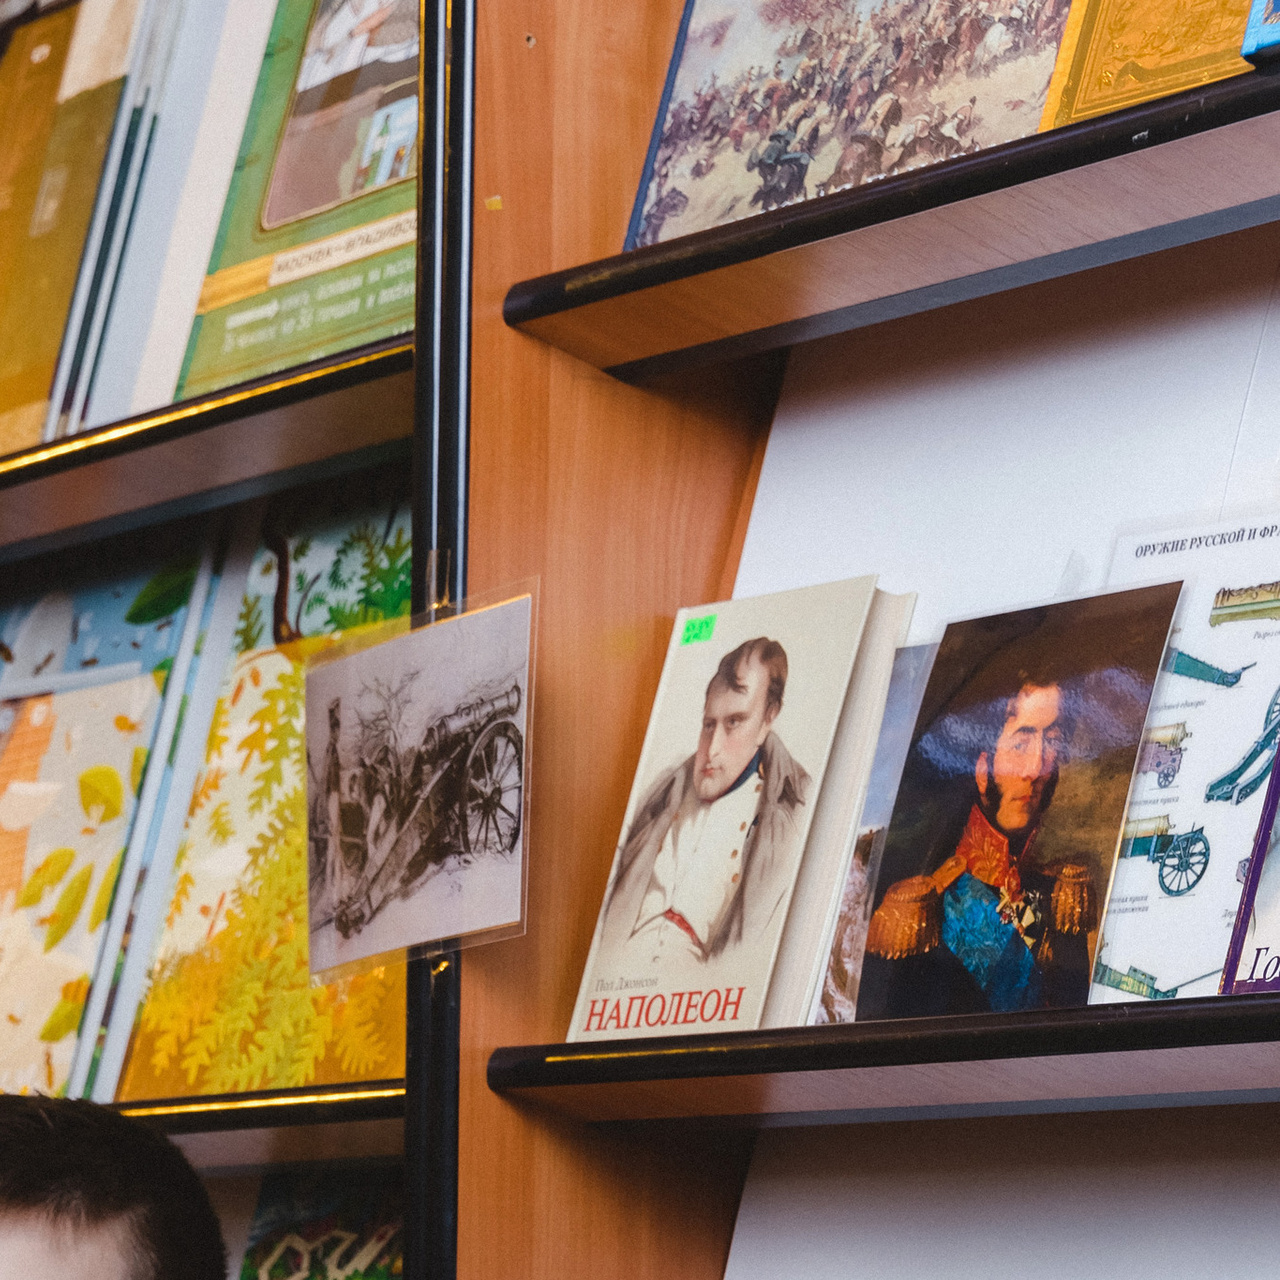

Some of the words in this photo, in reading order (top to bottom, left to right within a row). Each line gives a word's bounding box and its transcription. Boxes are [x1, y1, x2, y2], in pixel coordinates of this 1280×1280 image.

[1135, 538, 1188, 559] ОРУЖИЕ
[1189, 527, 1246, 550] РУССКОЙ
[1247, 527, 1258, 541] И
[1247, 946, 1280, 983] Го
[595, 978, 614, 992] Пол
[584, 987, 747, 1032] НАПОЛЕОН
